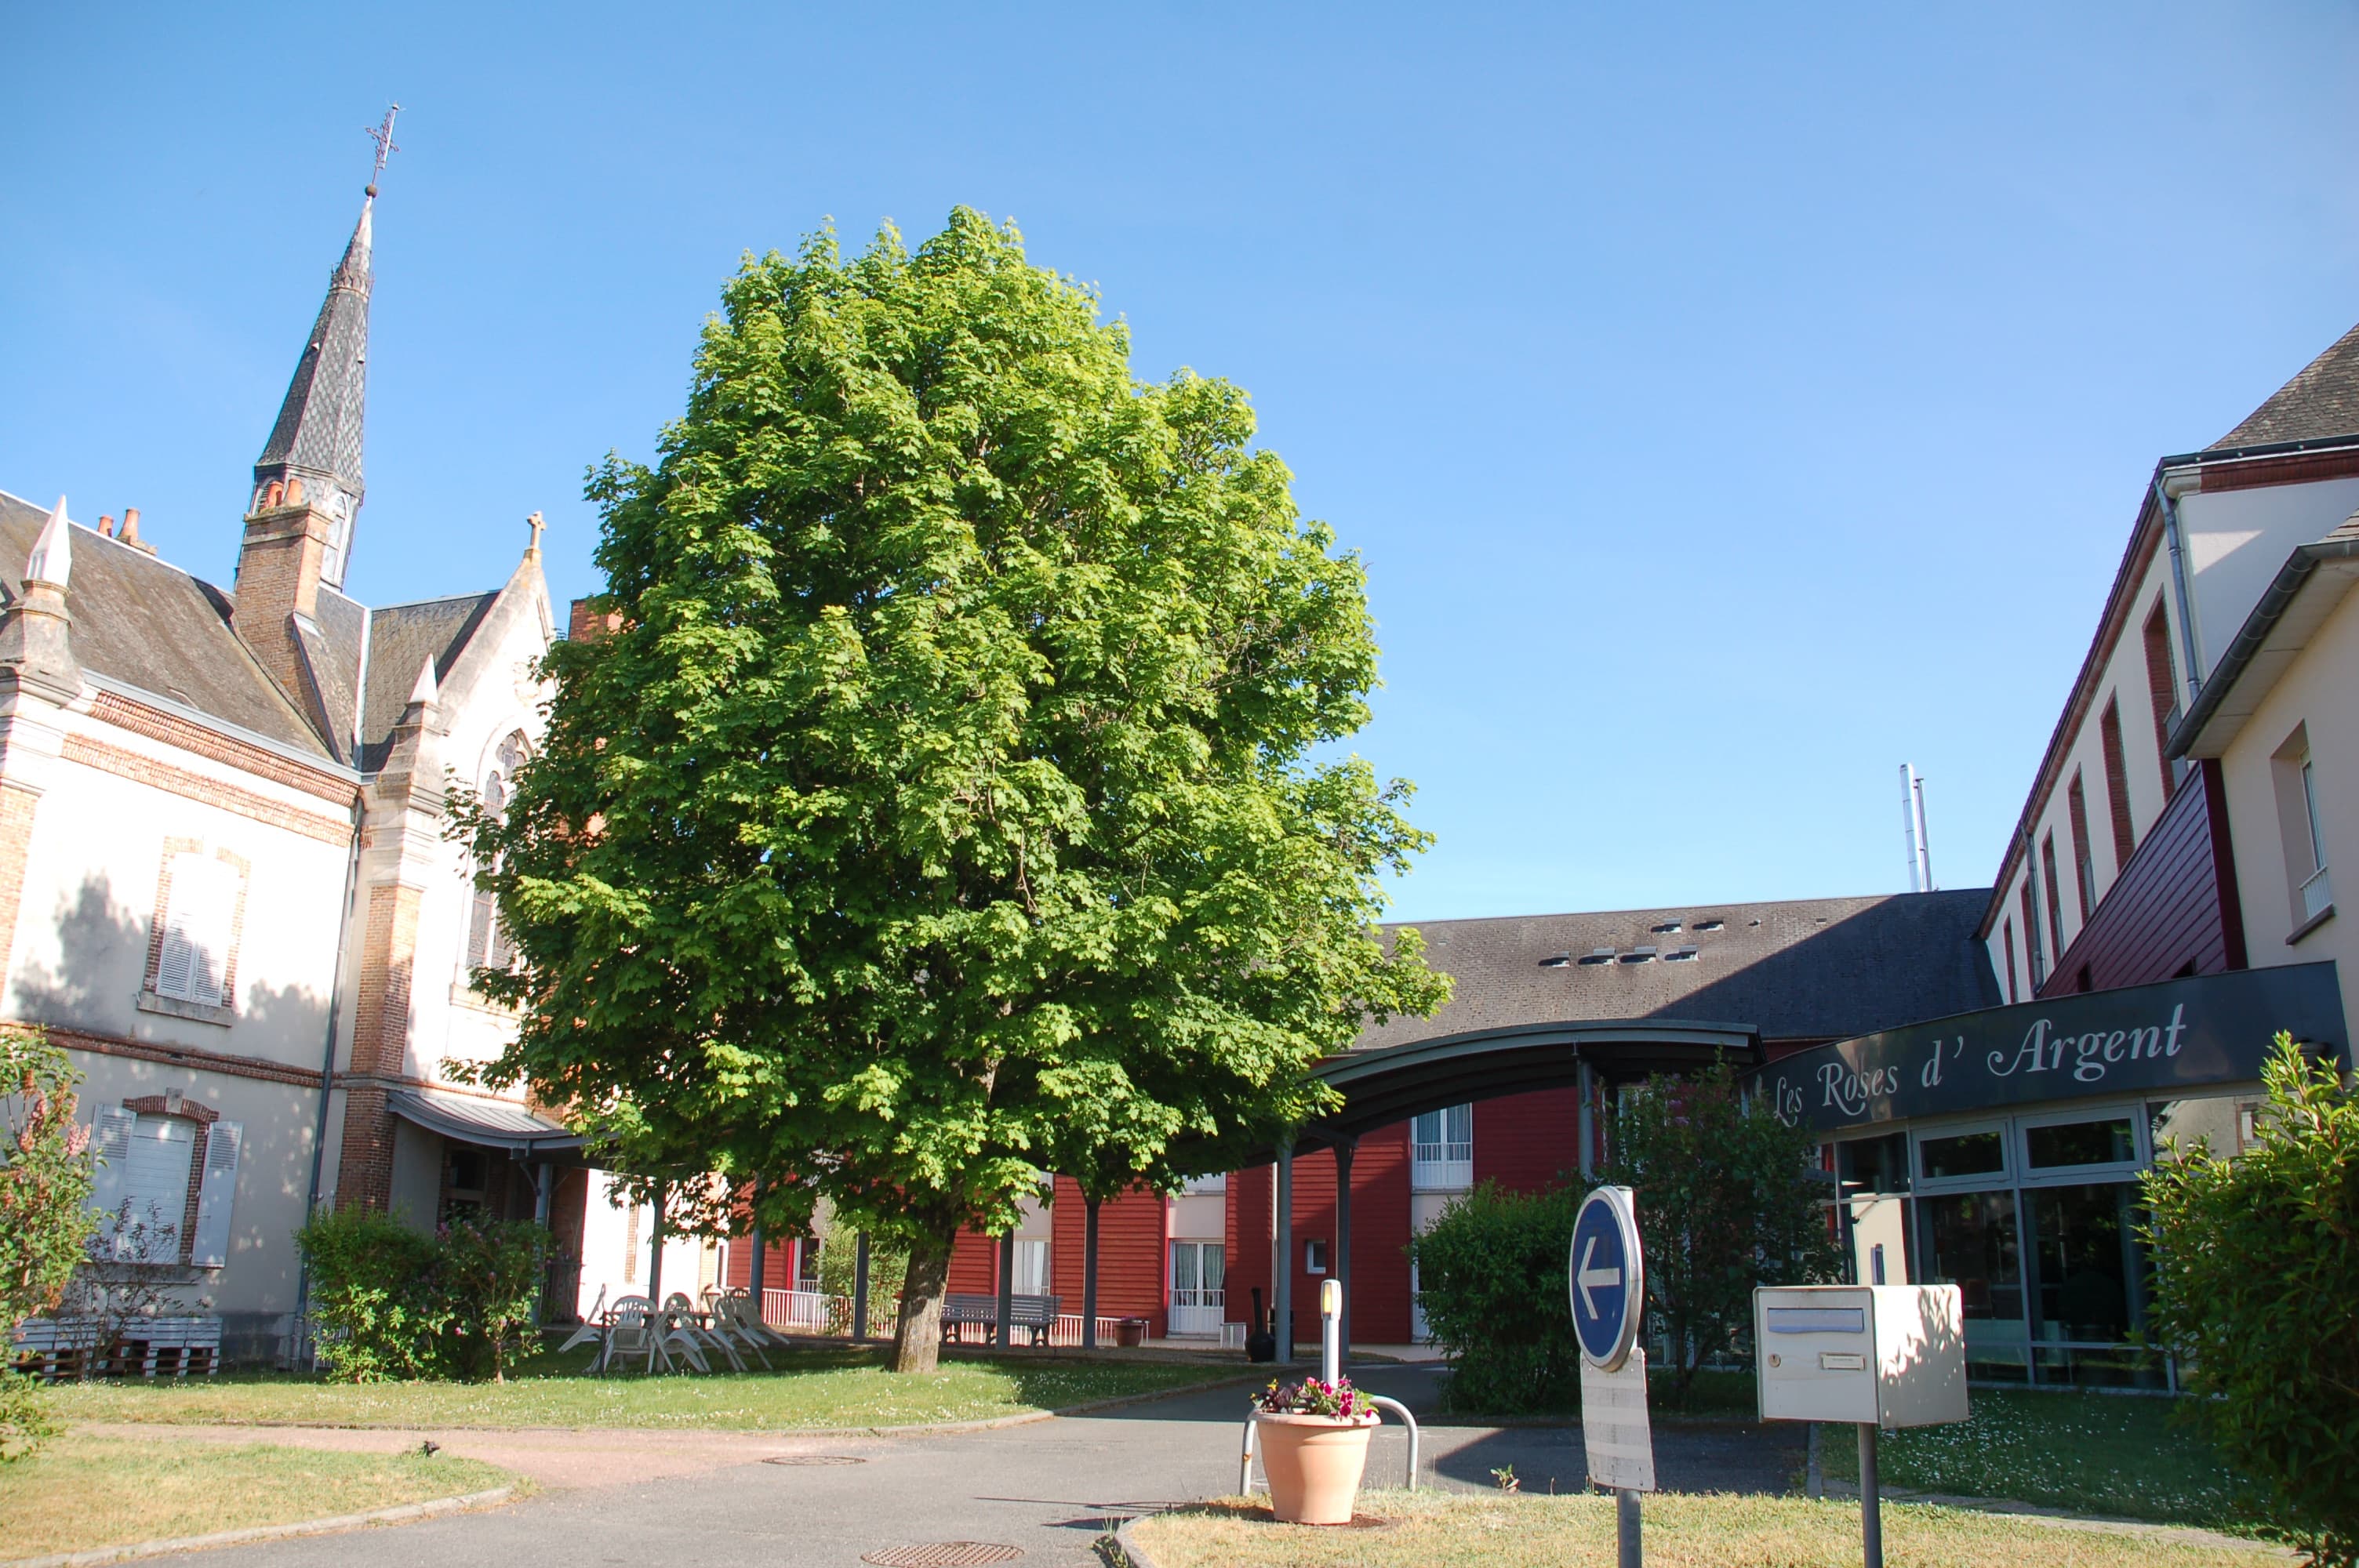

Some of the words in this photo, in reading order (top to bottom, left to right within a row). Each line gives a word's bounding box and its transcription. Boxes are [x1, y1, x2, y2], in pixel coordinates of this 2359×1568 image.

[1773, 1076, 1803, 1128] Les
[1816, 1062, 1899, 1116] Roses
[1986, 1003, 2187, 1083] Argent
